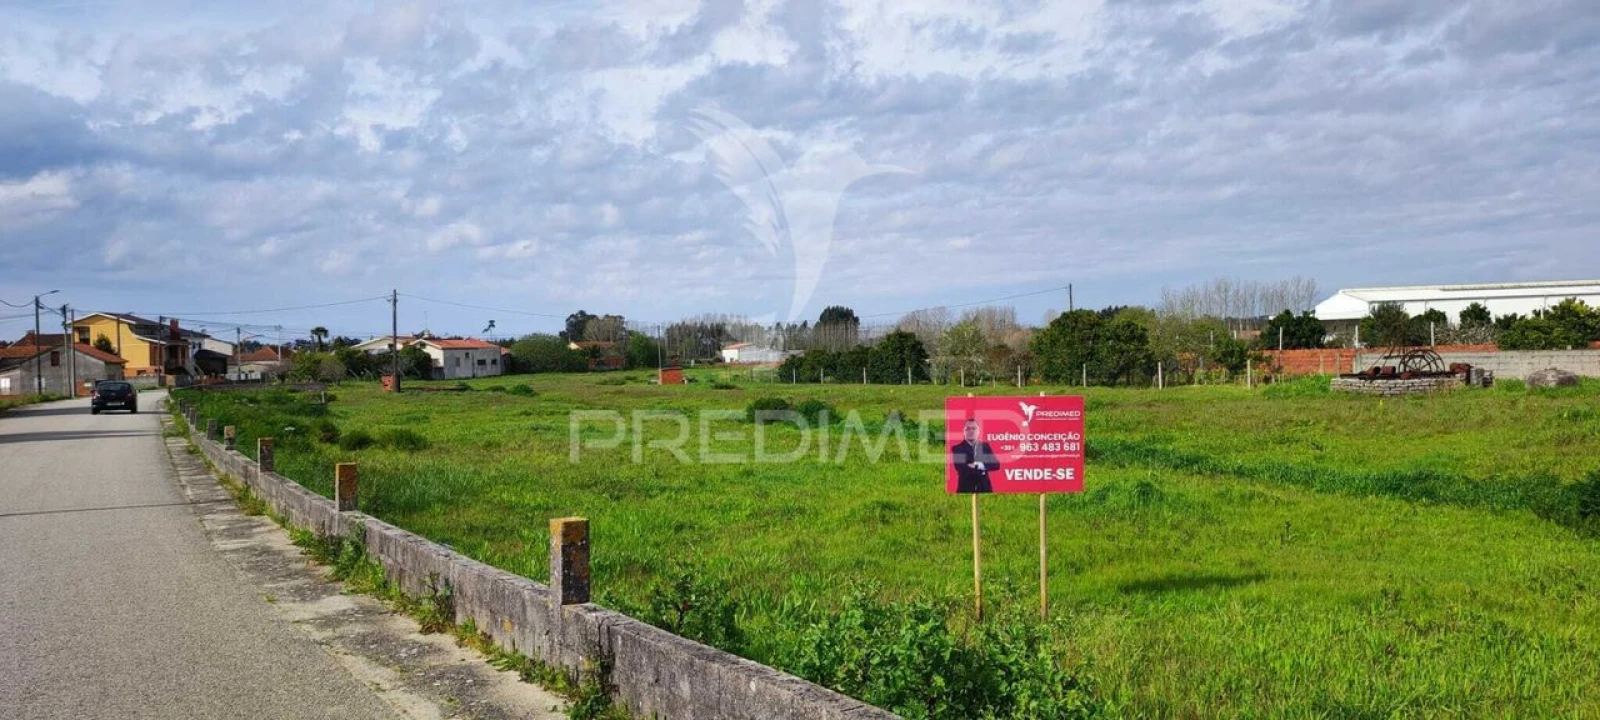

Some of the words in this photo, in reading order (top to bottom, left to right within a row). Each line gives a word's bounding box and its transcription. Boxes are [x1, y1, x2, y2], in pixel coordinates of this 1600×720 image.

[1027, 432, 1081, 442] CONCEIÇÃO
[1020, 442, 1039, 451] 963
[1041, 442, 1060, 451] 483
[1063, 442, 1081, 451] 681
[1004, 468, 1074, 480] VENDE-SE
